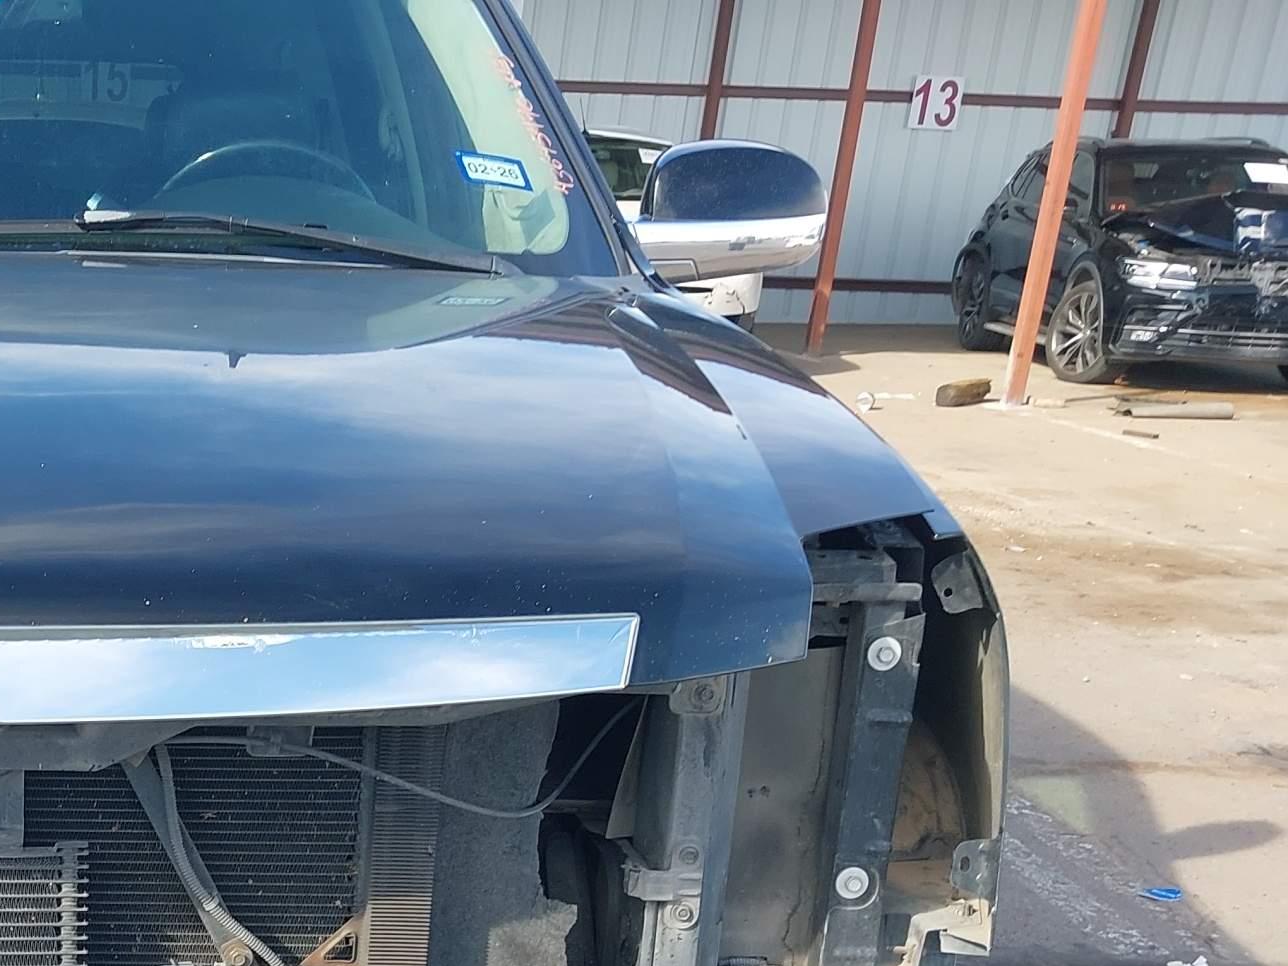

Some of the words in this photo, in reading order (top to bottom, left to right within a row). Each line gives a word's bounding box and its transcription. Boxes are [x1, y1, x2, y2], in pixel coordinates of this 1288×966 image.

[87, 61, 128, 102] 15
[914, 78, 960, 127] 13
[466, 161, 520, 180] 02-26
